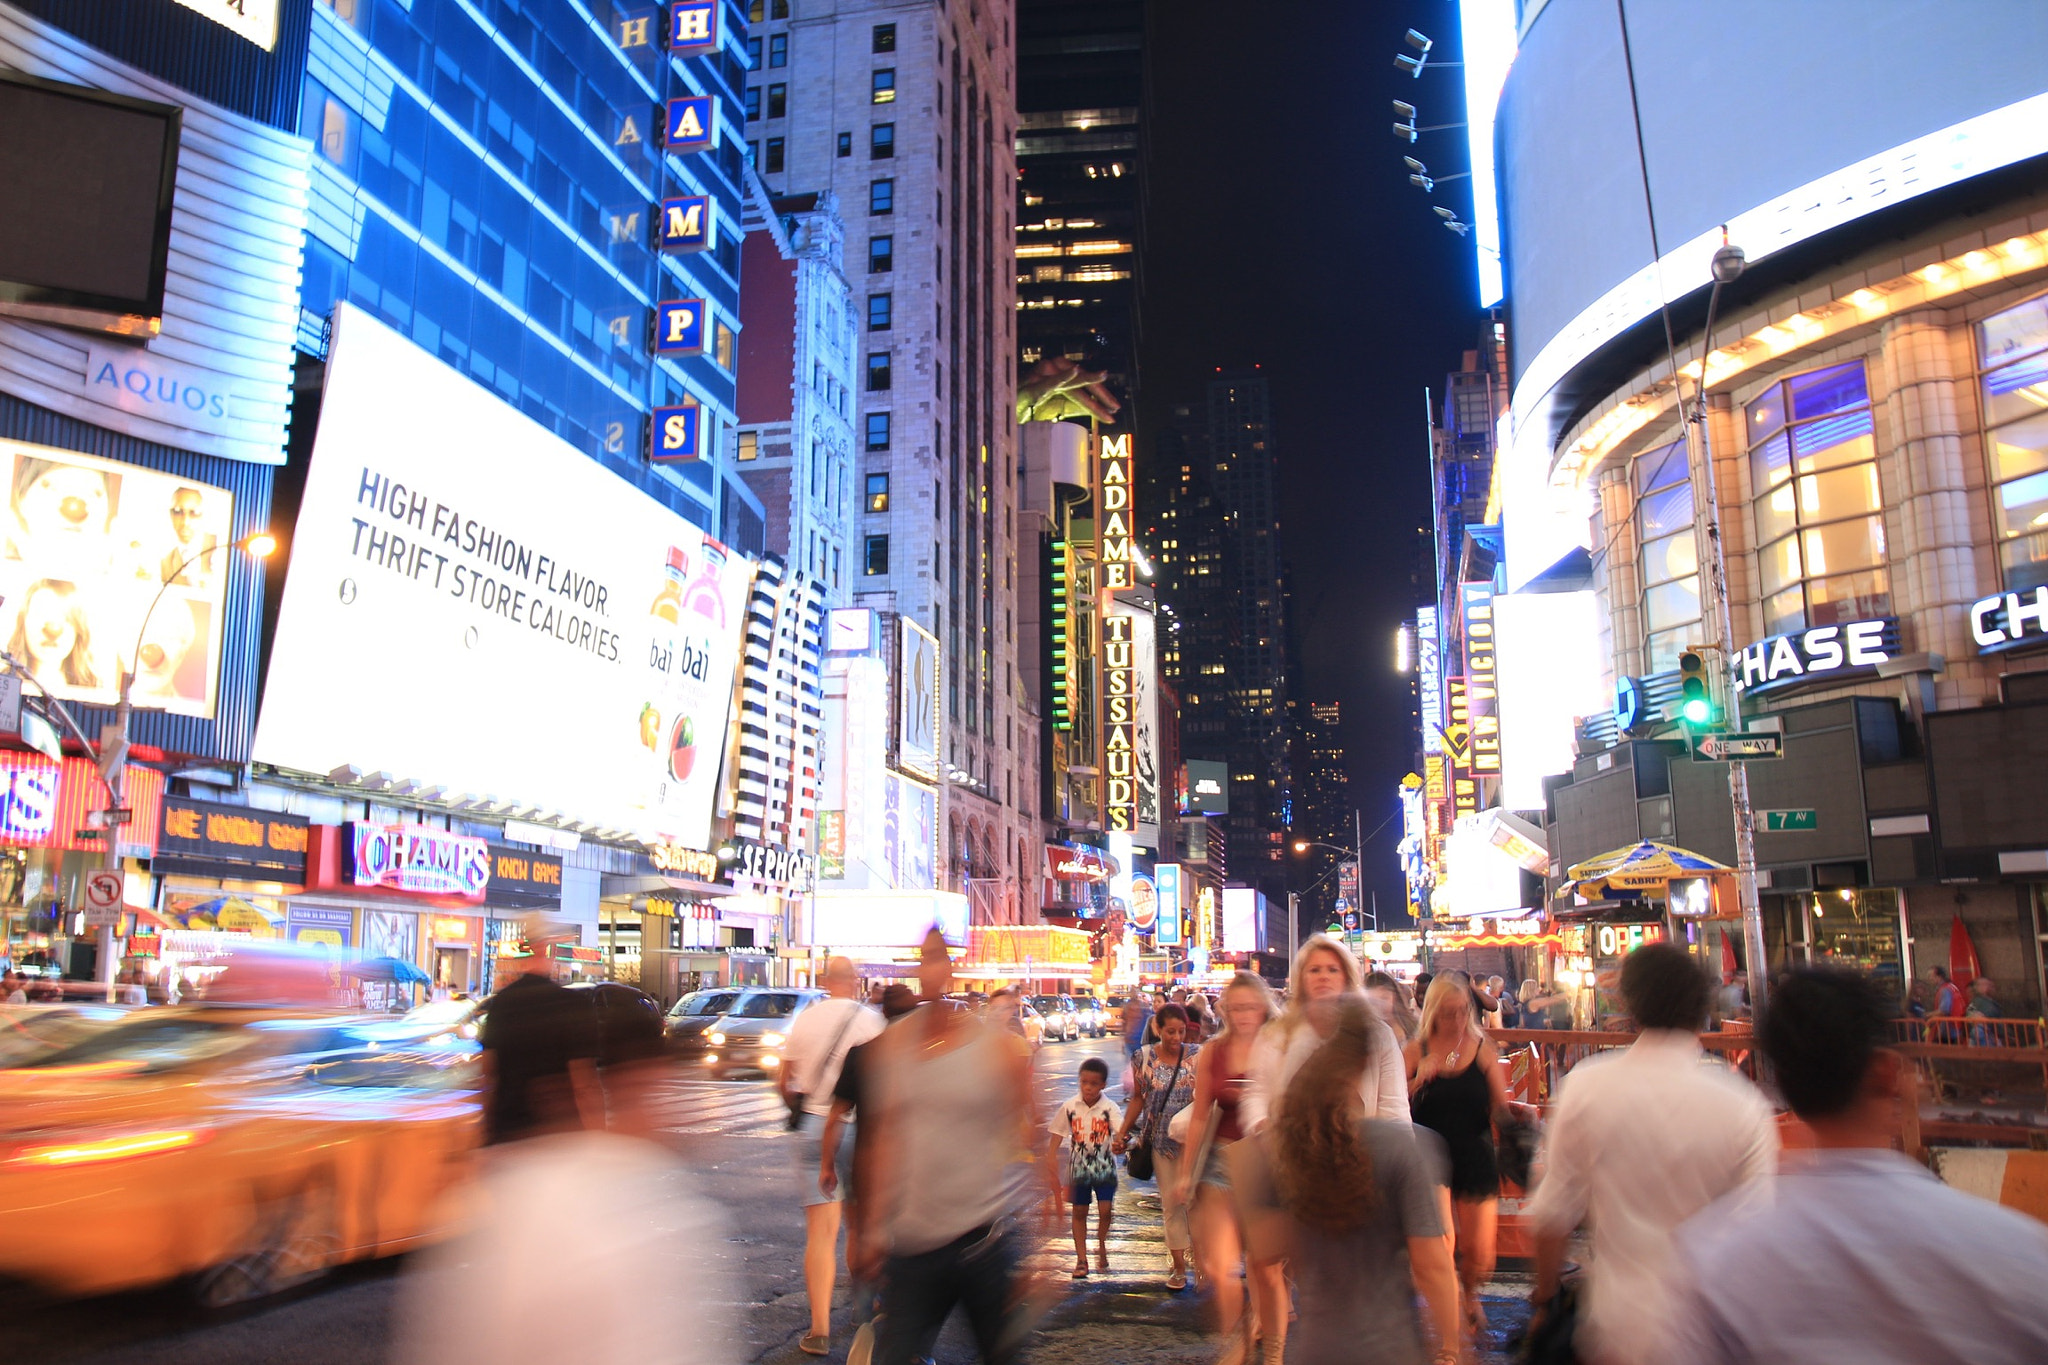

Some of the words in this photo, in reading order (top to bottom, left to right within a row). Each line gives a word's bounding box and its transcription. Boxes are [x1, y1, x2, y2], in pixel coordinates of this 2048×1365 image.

[95, 360, 225, 419] AQUOS
[1100, 433, 1129, 588] MADAME
[357, 467, 427, 530] HIGH
[430, 503, 532, 580] FASHION
[535, 555, 610, 618] FLAVOR.
[351, 517, 448, 589] THRIFT
[451, 565, 526, 623] STORE
[529, 600, 622, 665] CALORIES.
[1418, 606, 1437, 639] NEW
[1466, 589, 1497, 699] VICTORY
[649, 637, 674, 676] bai
[682, 635, 710, 683] bai
[1106, 616, 1131, 832] TUSSAUD'S
[1473, 715, 1500, 770] NEW
[1705, 742, 1731, 753] ONE
[1742, 740, 1770, 752] WAY
[826, 814, 839, 853] ART
[1776, 812, 1788, 829] 7
[1795, 812, 1807, 821] AV
[364, 829, 490, 889] CHAMPS
[497, 856, 528, 880] KNOW
[532, 861, 561, 885] GAME
[1600, 925, 1659, 956] OPEN
